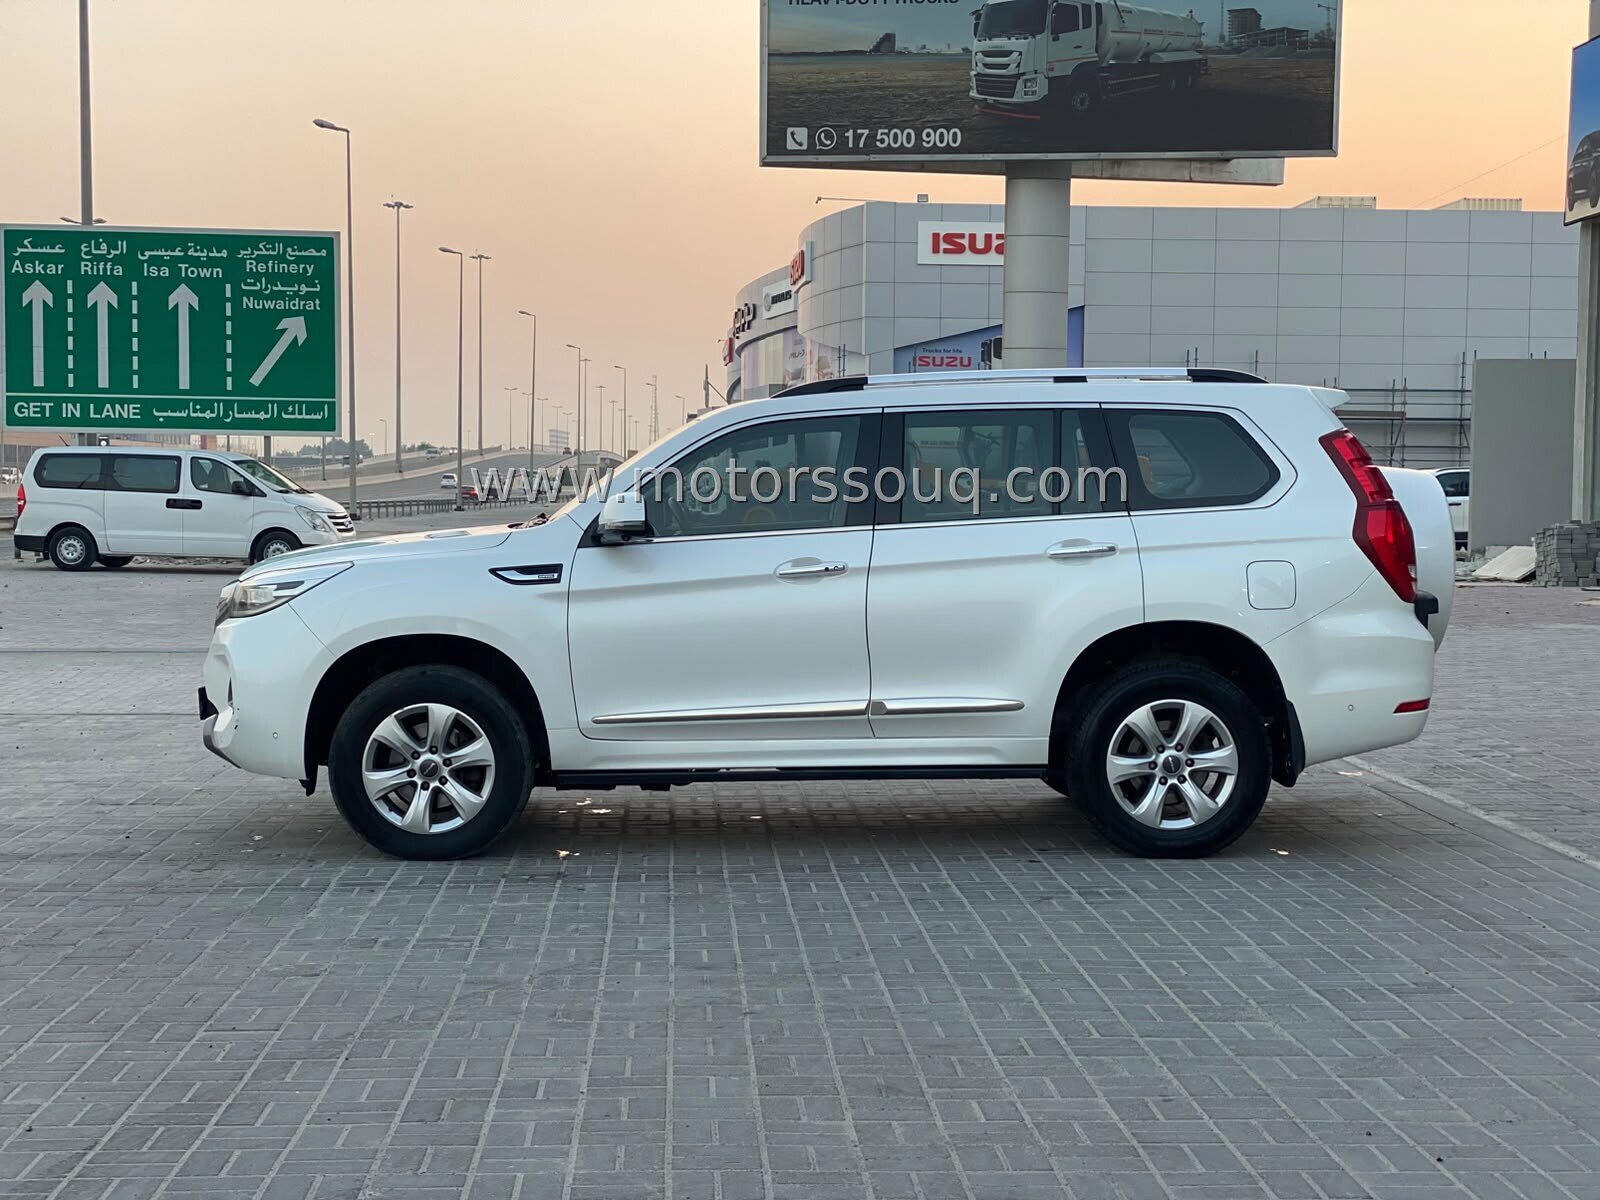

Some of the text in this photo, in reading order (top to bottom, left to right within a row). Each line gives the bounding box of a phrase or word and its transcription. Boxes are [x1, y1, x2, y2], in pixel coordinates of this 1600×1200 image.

[844, 128, 962, 148] 17 500 900
[12, 238, 65, 256] عسكر
[80, 238, 127, 259] الرفاع
[137, 242, 228, 260] مدينة عيسى
[236, 242, 327, 260] مصنع التكرير
[11, 260, 64, 275] Askar
[80, 261, 123, 276] Riffa
[143, 263, 223, 278] Isa Town
[246, 260, 314, 276] Refinery
[241, 277, 321, 294] نويدرات
[242, 296, 321, 311] Nuwaidrat
[13, 402, 141, 419] GET IN LANE
[152, 402, 328, 422] اسلك المسار المناسب
